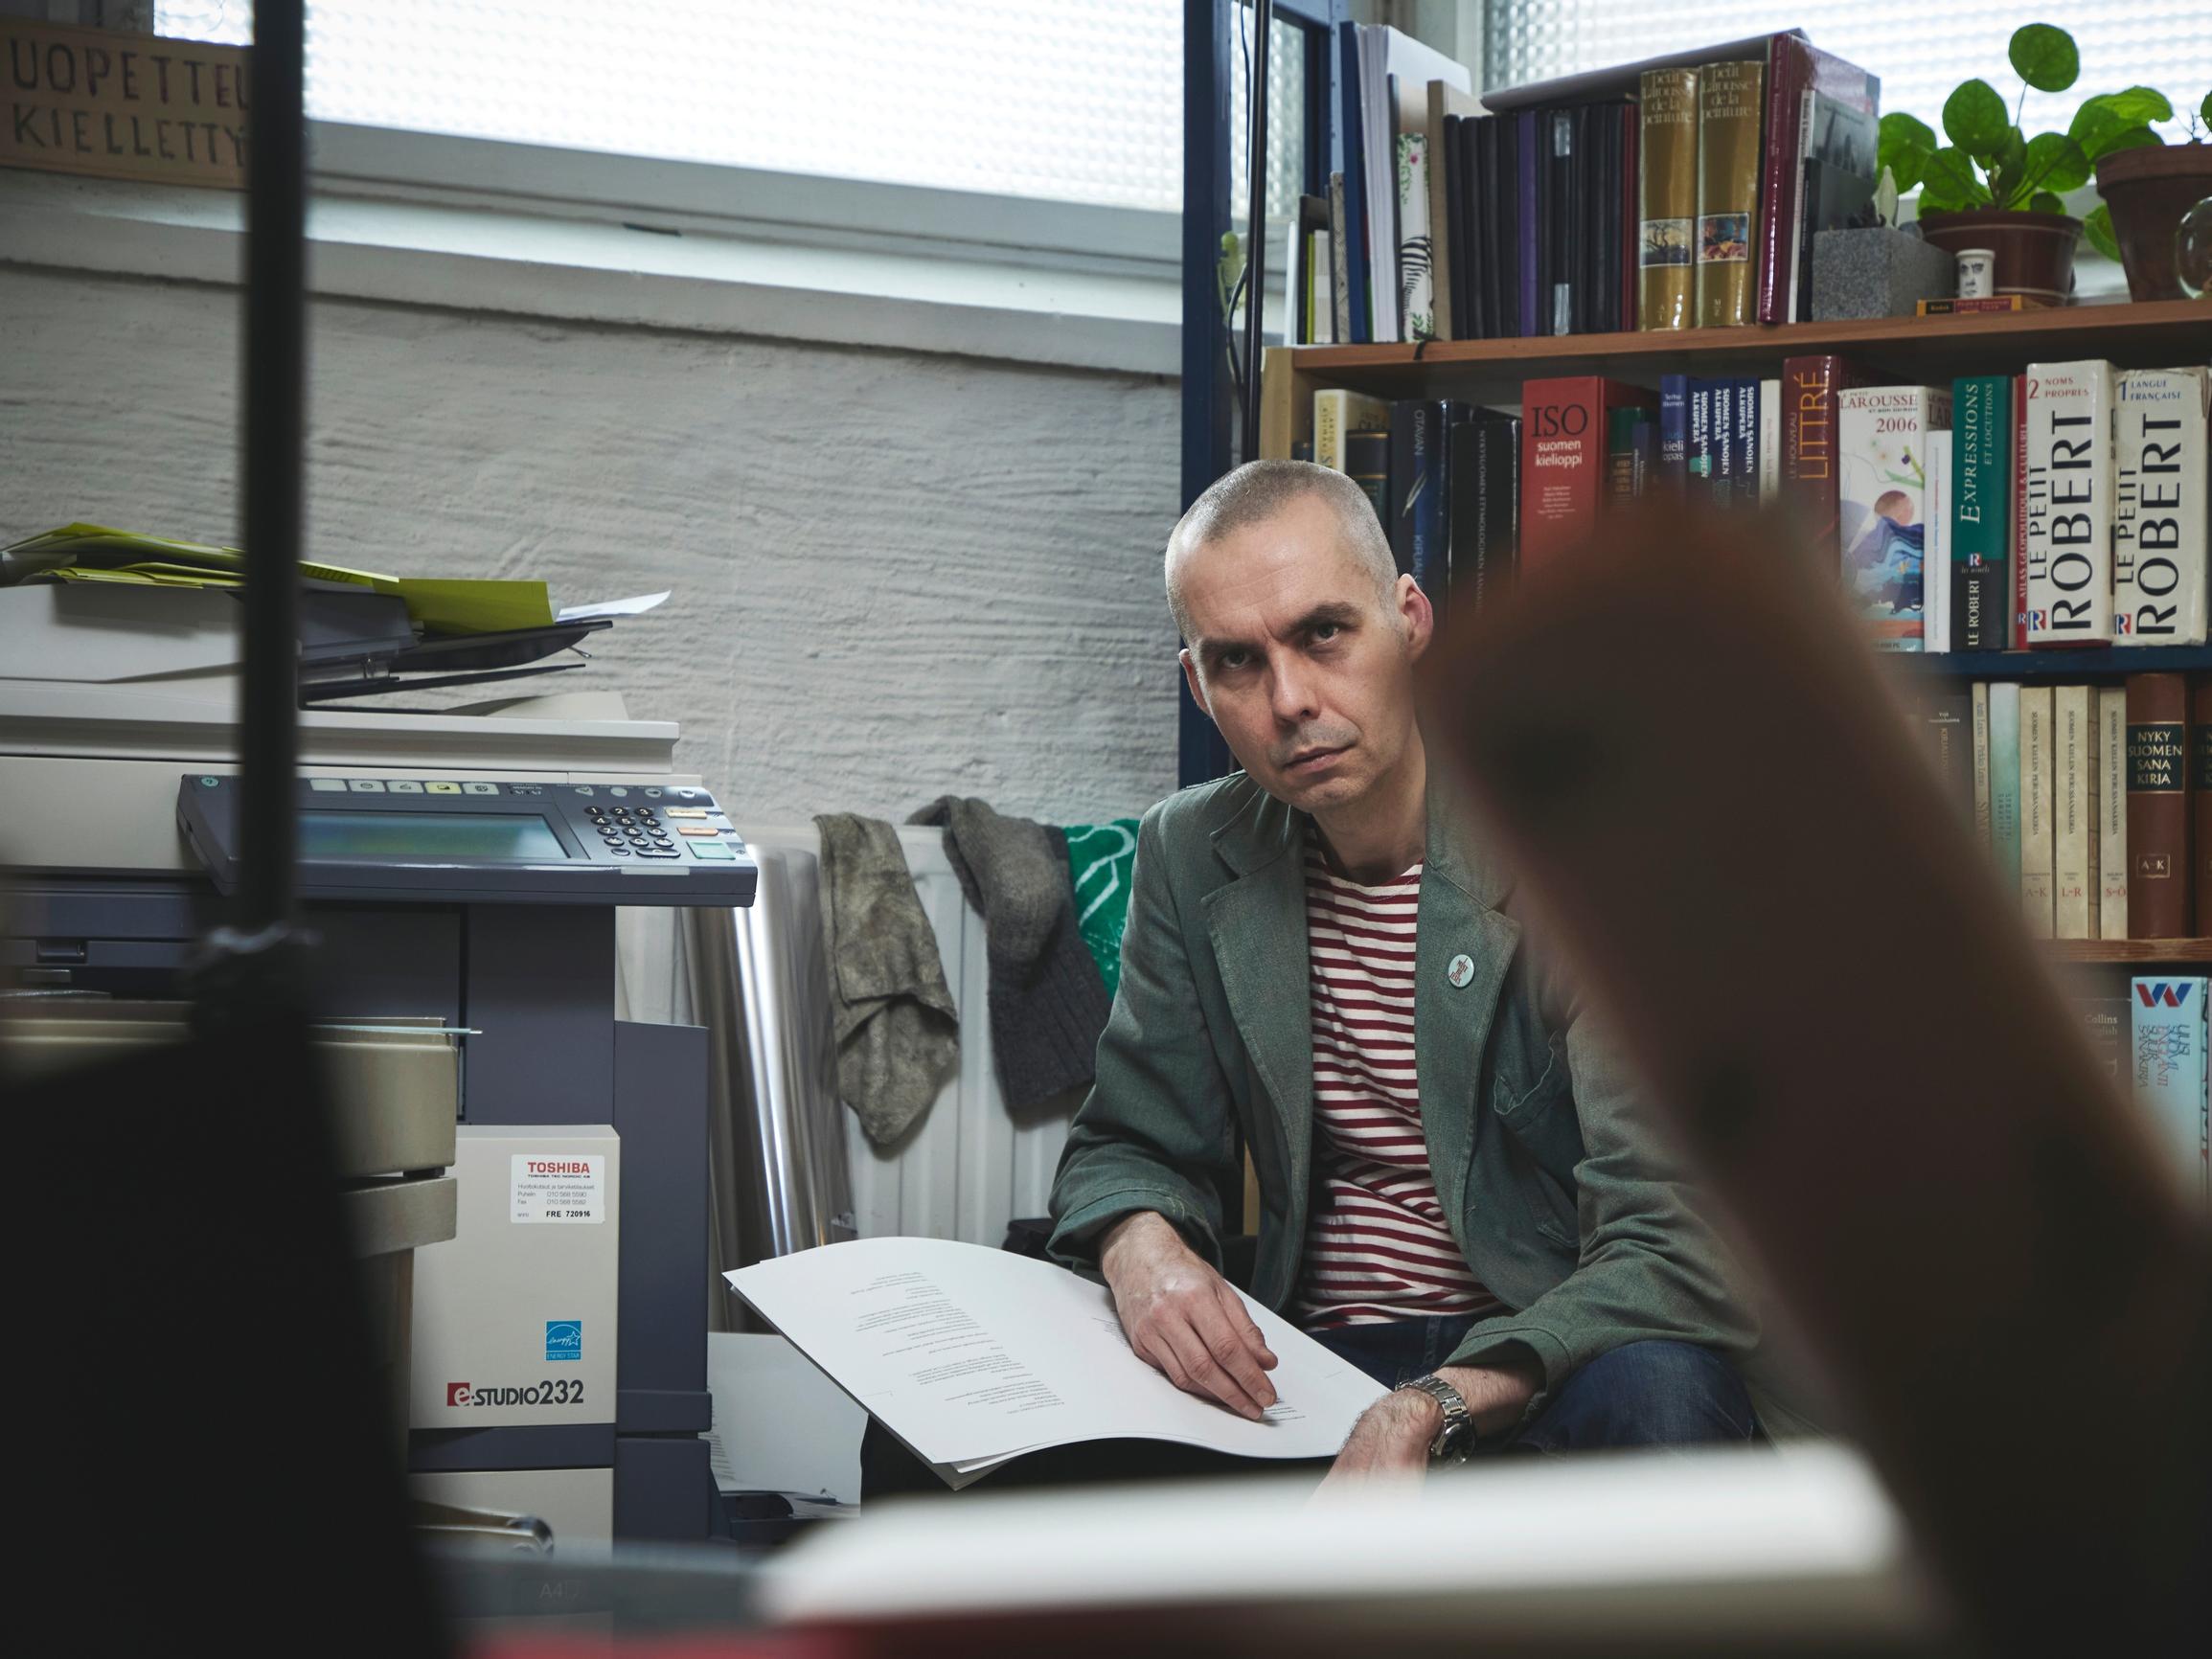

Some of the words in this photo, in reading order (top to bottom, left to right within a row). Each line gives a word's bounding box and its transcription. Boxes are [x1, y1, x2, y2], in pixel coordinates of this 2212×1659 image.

[13, 102, 246, 168] KIELLETTY
[2029, 379, 2040, 399] 2
[2045, 376, 2074, 386] NOMS
[2117, 379, 2128, 400] 1
[2131, 379, 2168, 388] LANGUE
[1839, 394, 1918, 409] LAROUSSE
[2045, 389, 2089, 398] PROPRES
[2131, 391, 2183, 401] FRANÇAISE
[1700, 391, 1709, 432] SUOMEN
[1746, 386, 1755, 428] SUOMEN
[1985, 383, 1994, 448] LOCUTIONS
[1532, 404, 1588, 438] ISO
[1793, 372, 1829, 479] LITTRÉ
[1876, 418, 1918, 433] 2006
[1414, 409, 1425, 456] OTAVAN
[1538, 440, 1582, 451] suomen
[1663, 440, 1684, 452] kieli
[1700, 434, 1709, 478] SANOJEN
[1722, 431, 1730, 474] SANOJEN
[1745, 430, 1754, 473] SANOJEN
[1960, 383, 1980, 524] EXPRESSIONS
[1536, 452, 1583, 468] kielioppi
[1984, 450, 1993, 466] ET
[2029, 466, 2047, 537] PETIT
[2117, 468, 2136, 539] PETIT
[2051, 410, 2093, 629] ROBERT
[2136, 413, 2182, 634] ROBERT
[2029, 551, 2047, 580] LE
[2116, 554, 2134, 583] LE
[1969, 580, 1980, 627] ROBERT
[1968, 631, 1979, 647] LE
[2137, 731, 2171, 742] NYKY
[2128, 745, 2182, 758] SUOMEN
[2137, 759, 2172, 770] SANA
[2137, 773, 2172, 785] KIRJA
[2085, 1014, 2118, 1025] Collins
[527, 1162, 590, 1173] TOSHIBA
